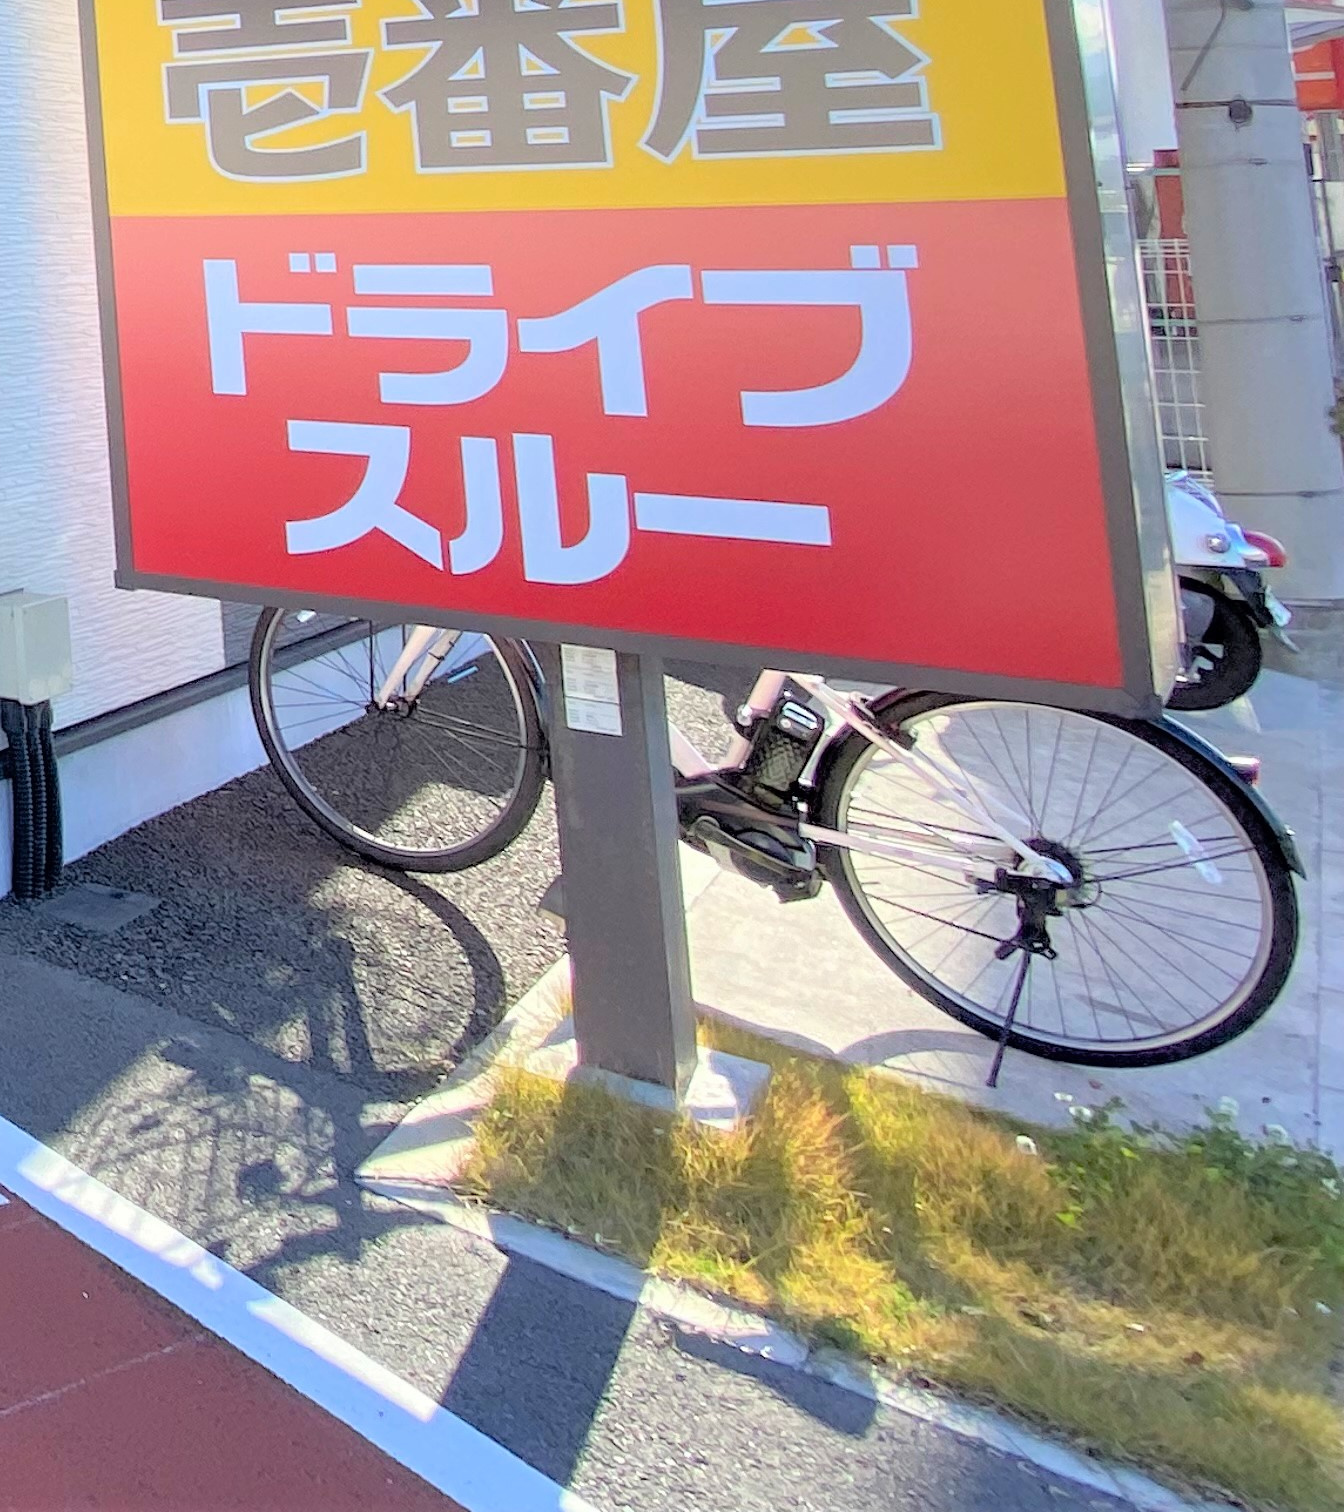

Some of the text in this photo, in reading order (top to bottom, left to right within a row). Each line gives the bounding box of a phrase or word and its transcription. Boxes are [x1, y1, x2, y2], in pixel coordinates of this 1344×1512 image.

[202, 243, 919, 429] ドライブ
[285, 419, 832, 585] スルー
